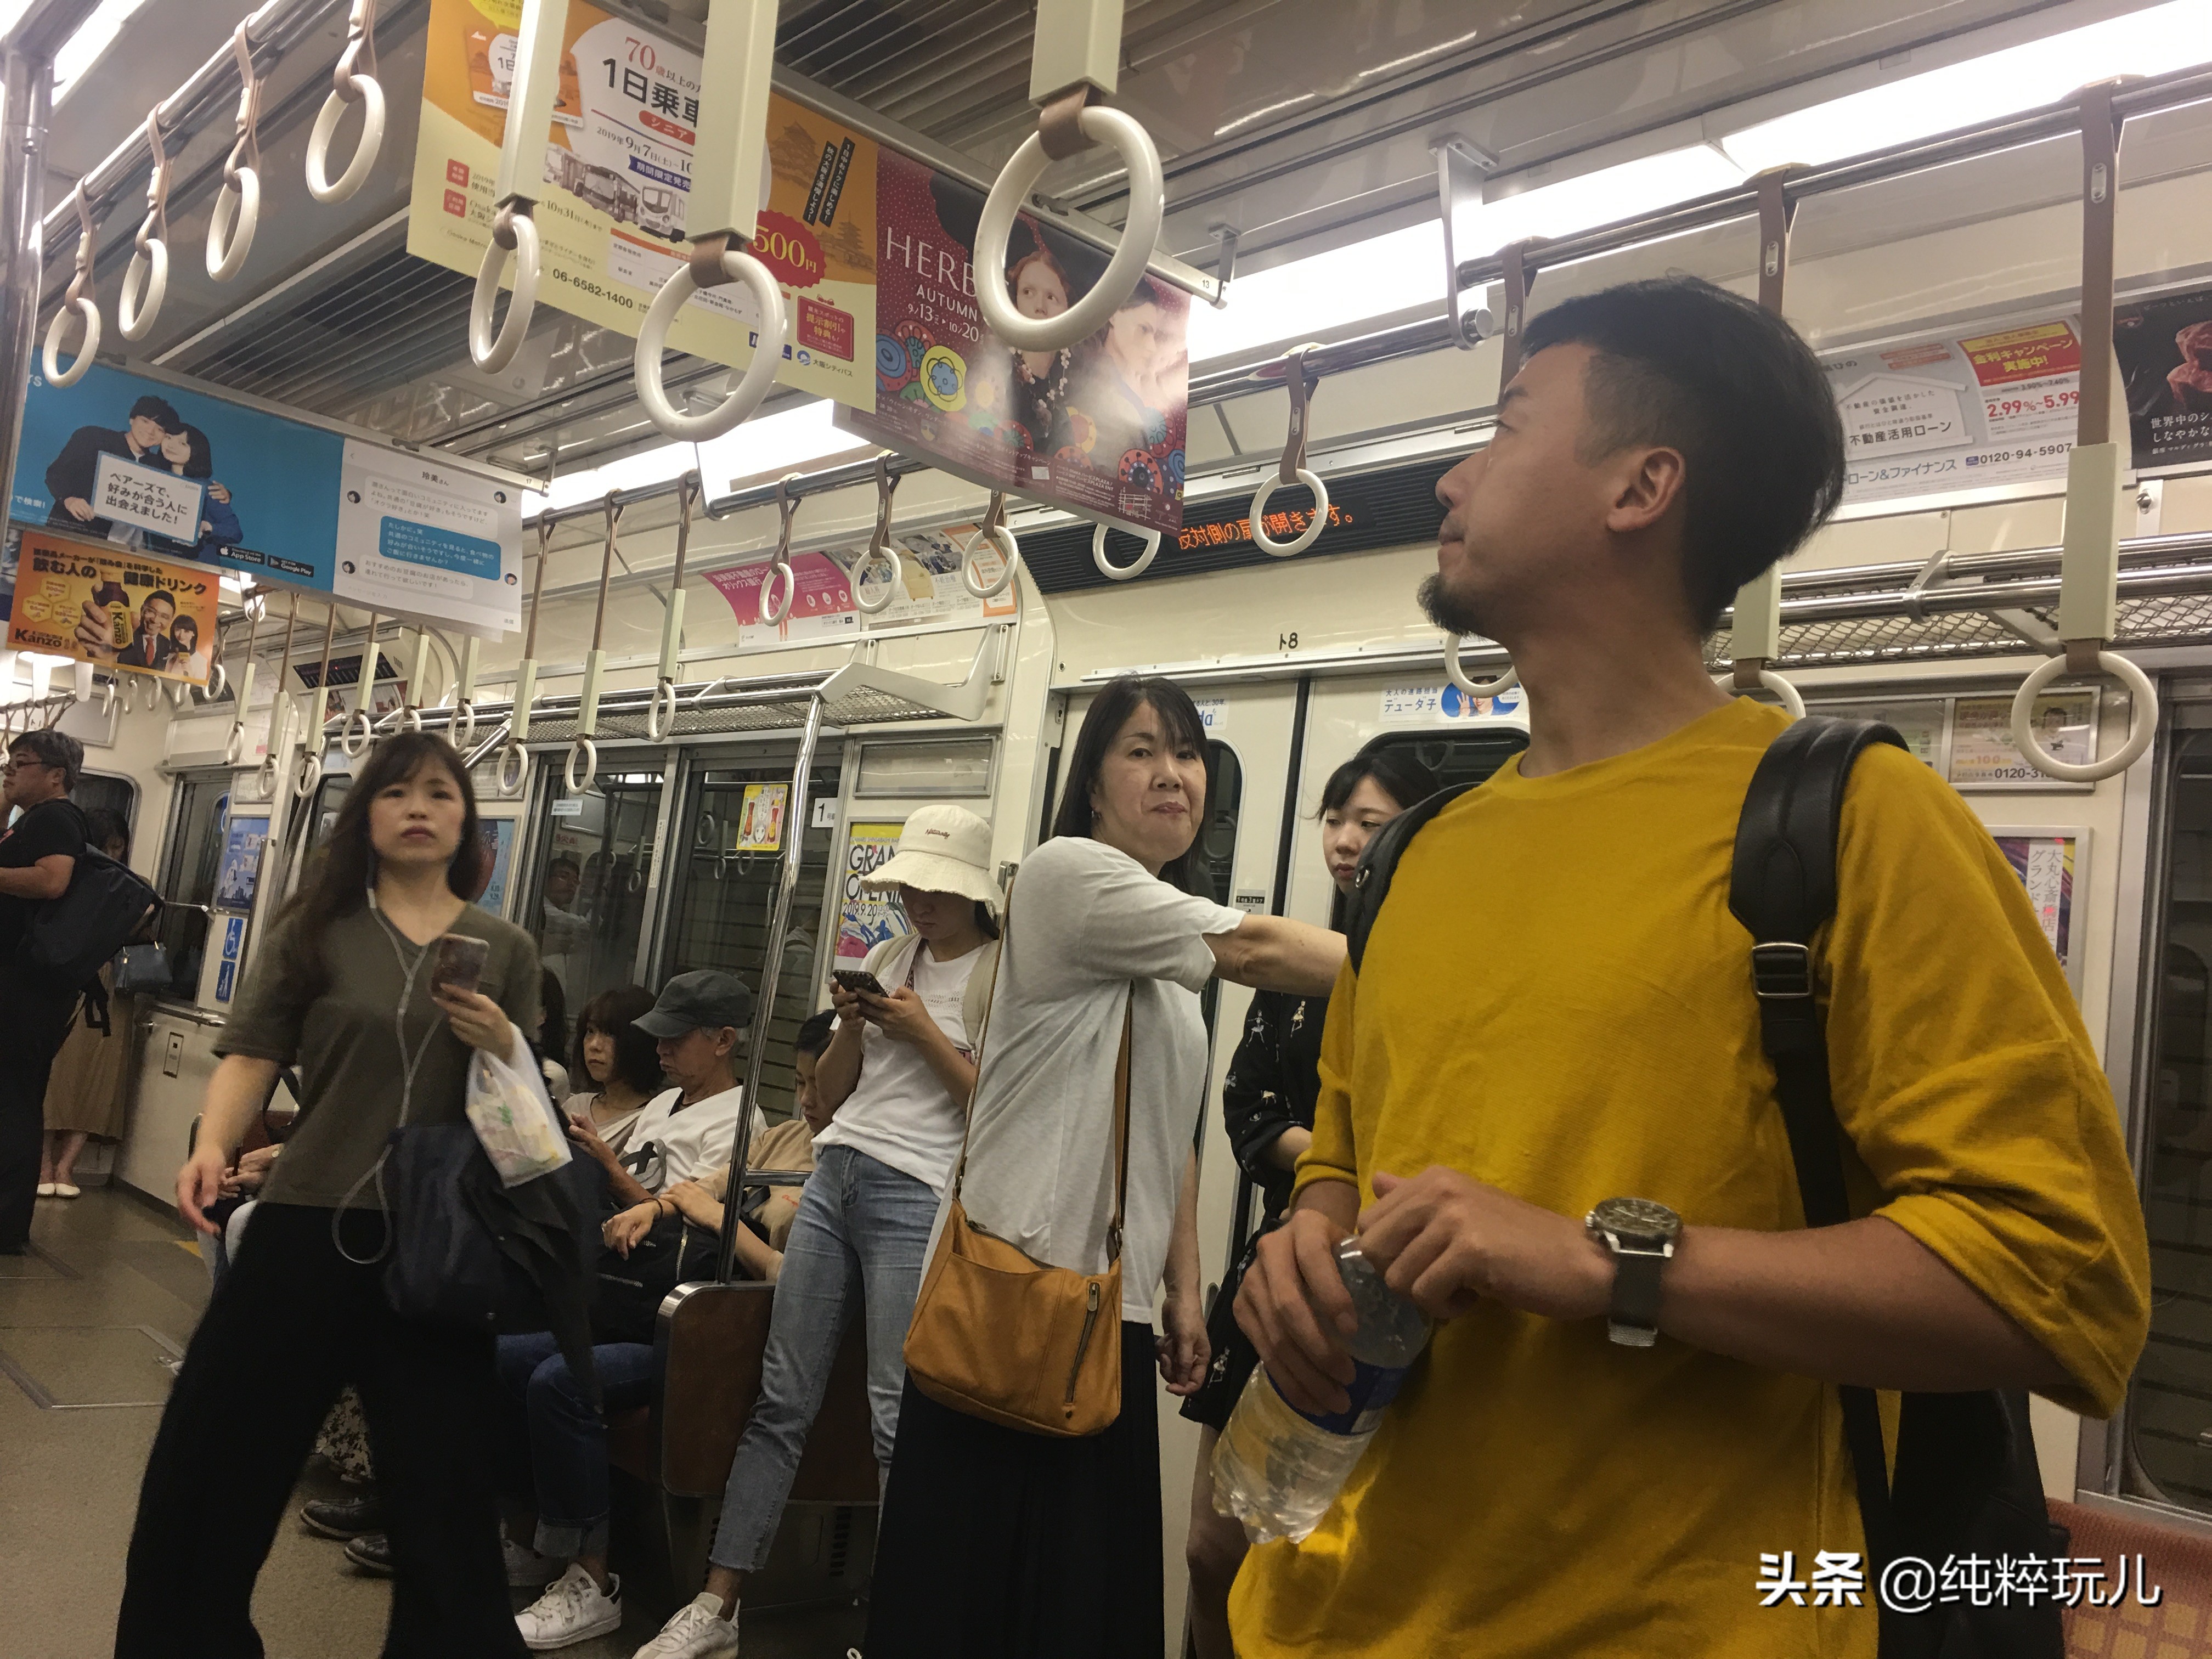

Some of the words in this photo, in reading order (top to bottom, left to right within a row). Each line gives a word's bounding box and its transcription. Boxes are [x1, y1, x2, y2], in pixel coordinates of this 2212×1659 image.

[651, 117, 687, 138] シニア
[553, 268, 633, 308] 06-6582-1400
[1202, 279, 1210, 289] 13
[917, 284, 977, 322] AUTUMN
[907, 303, 933, 321] 9/13
[949, 322, 979, 342] 10/20
[1973, 339, 2073, 365] 金利キャンペーン
[812, 359, 853, 377] 大阪シティバス
[2003, 356, 2049, 373] 実施中!
[2151, 413, 2212, 429] 世界中のシ
[1849, 421, 1952, 447] 不動産活用ローン
[2153, 426, 2210, 443] しなやかな
[1979, 442, 2072, 464] 0120-94-5907
[422, 471, 449, 487] 玲美さん
[108, 482, 189, 515] 好みが合う人に
[105, 495, 178, 524] 出会えました!
[231, 550, 244, 560] App
[245, 554, 261, 562] Store
[32, 557, 97, 579] 飲む人の
[281, 563, 300, 573] Google
[301, 567, 312, 576] Play
[722, 577, 764, 590] オリックス銀行
[112, 612, 123, 645] Kanzo
[14, 628, 63, 648] Kanzo
[1385, 687, 1438, 697] 大人の進路担当
[1384, 698, 1437, 713] デューダ子
[1994, 768, 2053, 779] 0120-31
[818, 803, 825, 822] 1
[924, 828, 950, 840] Naturally
[2041, 849, 2062, 947] 大丸心斎橋店
[842, 902, 878, 917] 2019.9.20
